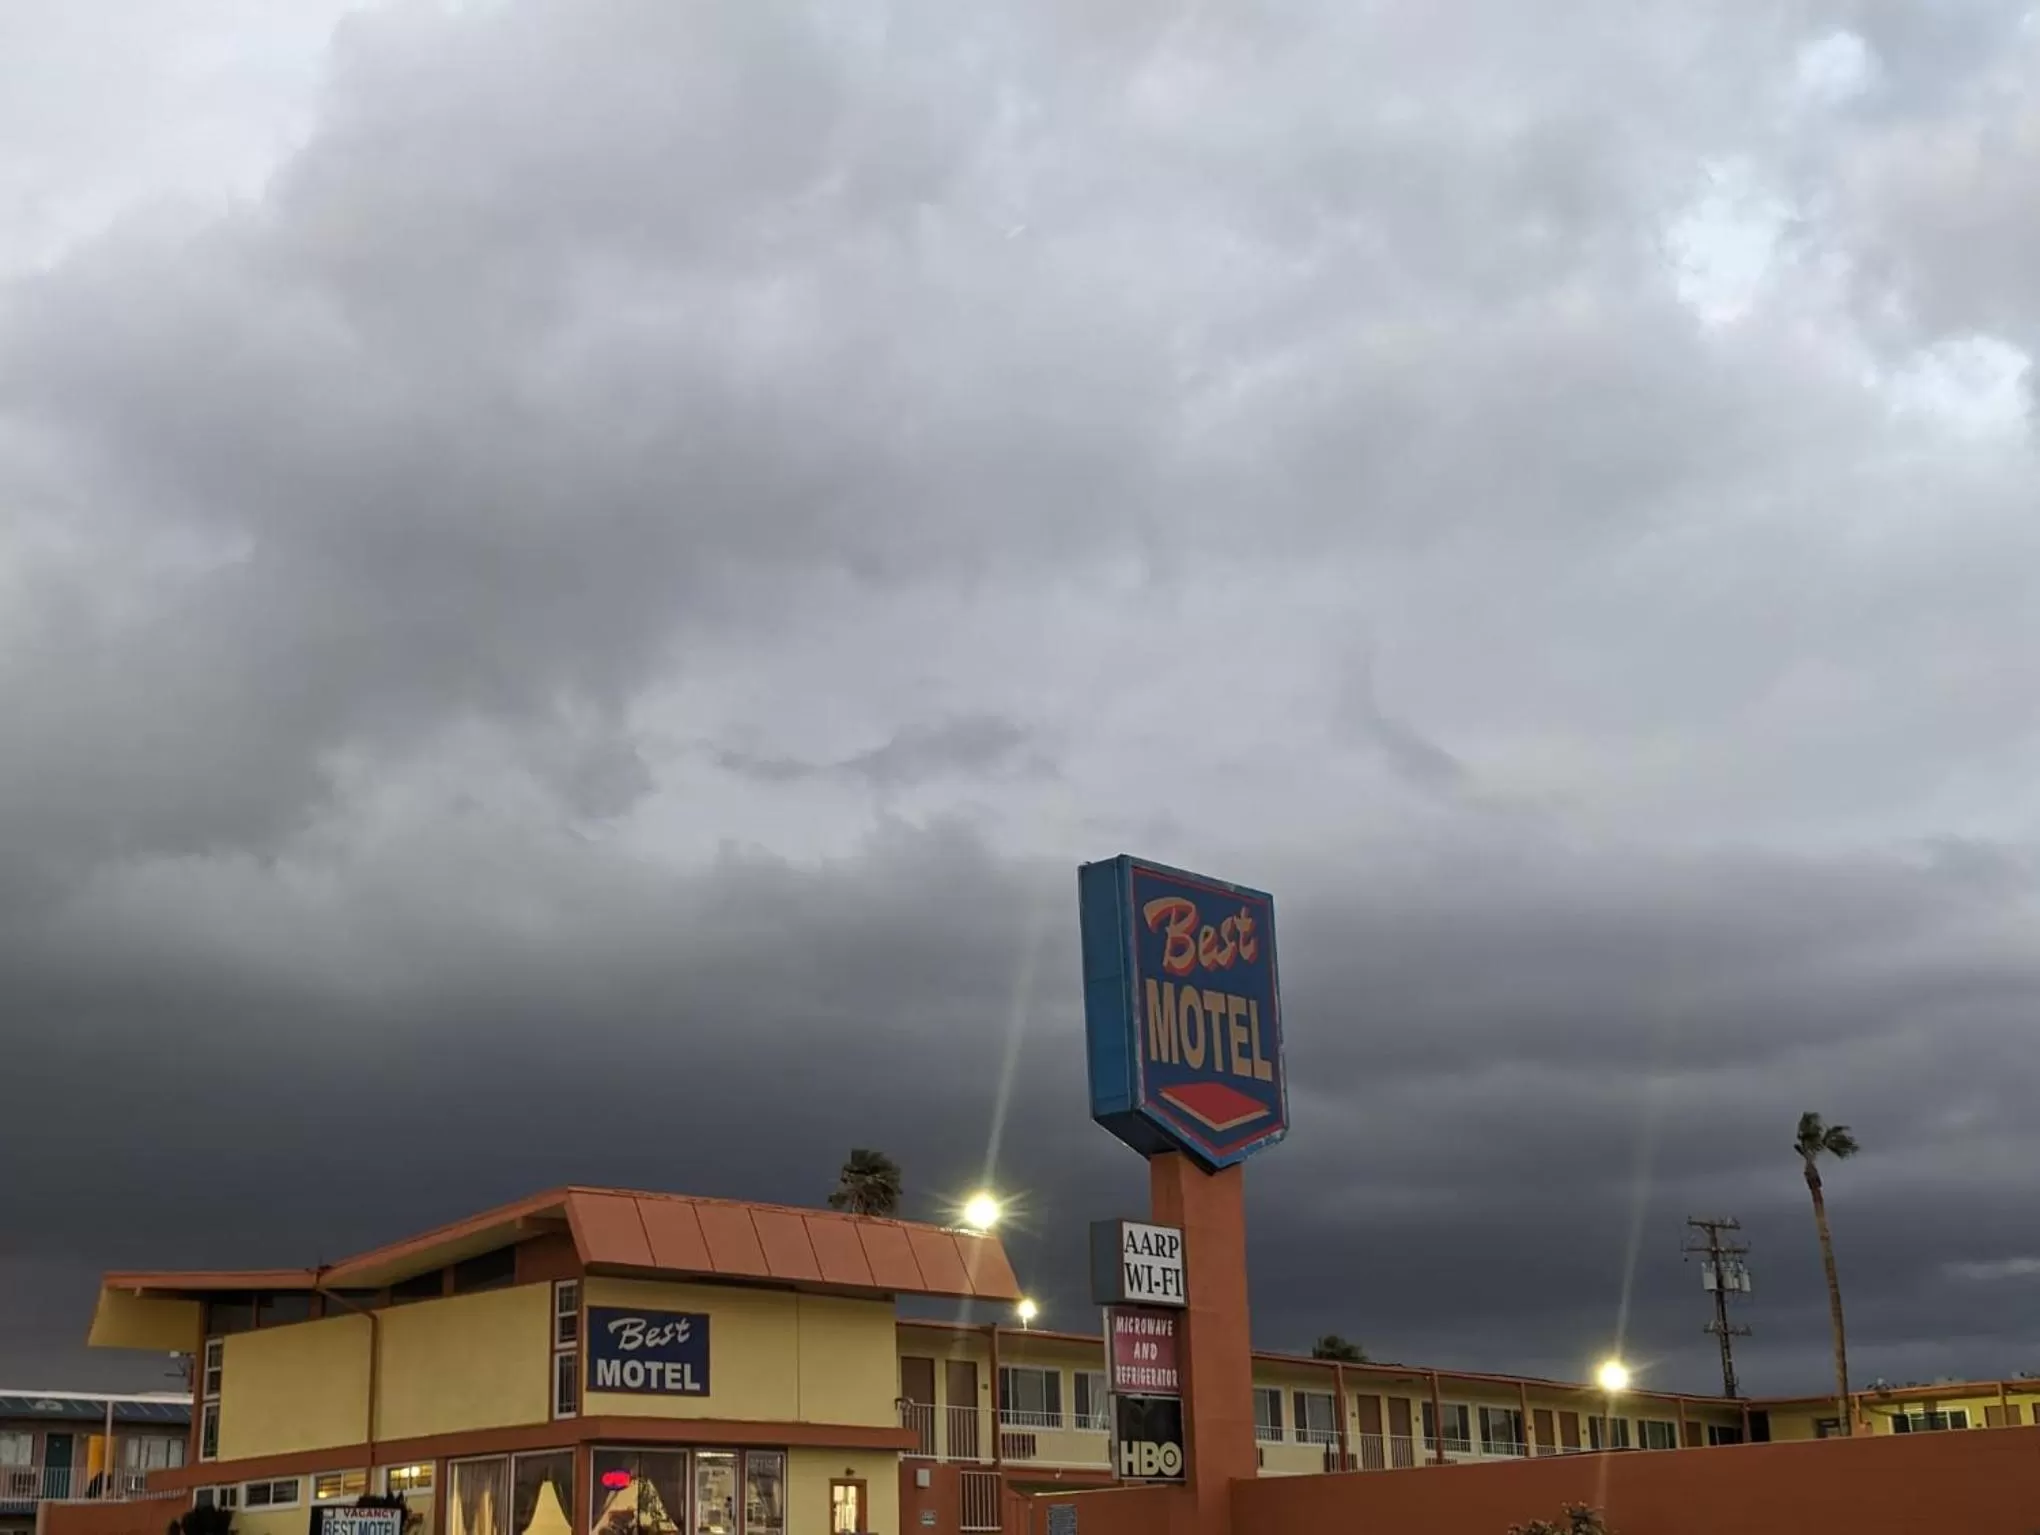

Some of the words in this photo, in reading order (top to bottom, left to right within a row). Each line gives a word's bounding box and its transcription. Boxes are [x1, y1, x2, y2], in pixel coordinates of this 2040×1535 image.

[1143, 897, 1258, 976] Best
[1146, 979, 1273, 1082] MOTEL
[1124, 1230, 1179, 1258] AARP
[1124, 1263, 1182, 1296] WI-FI
[608, 1317, 690, 1350] Best
[1116, 1316, 1173, 1336] MICROWAVE
[1134, 1341, 1158, 1360] AND
[597, 1359, 700, 1390] MOTEL
[1116, 1365, 1179, 1387] REFRIGERATOR
[1120, 1440, 1183, 1476] HBO
[324, 1520, 357, 1535] BEST
[344, 1508, 397, 1518] VACANCY
